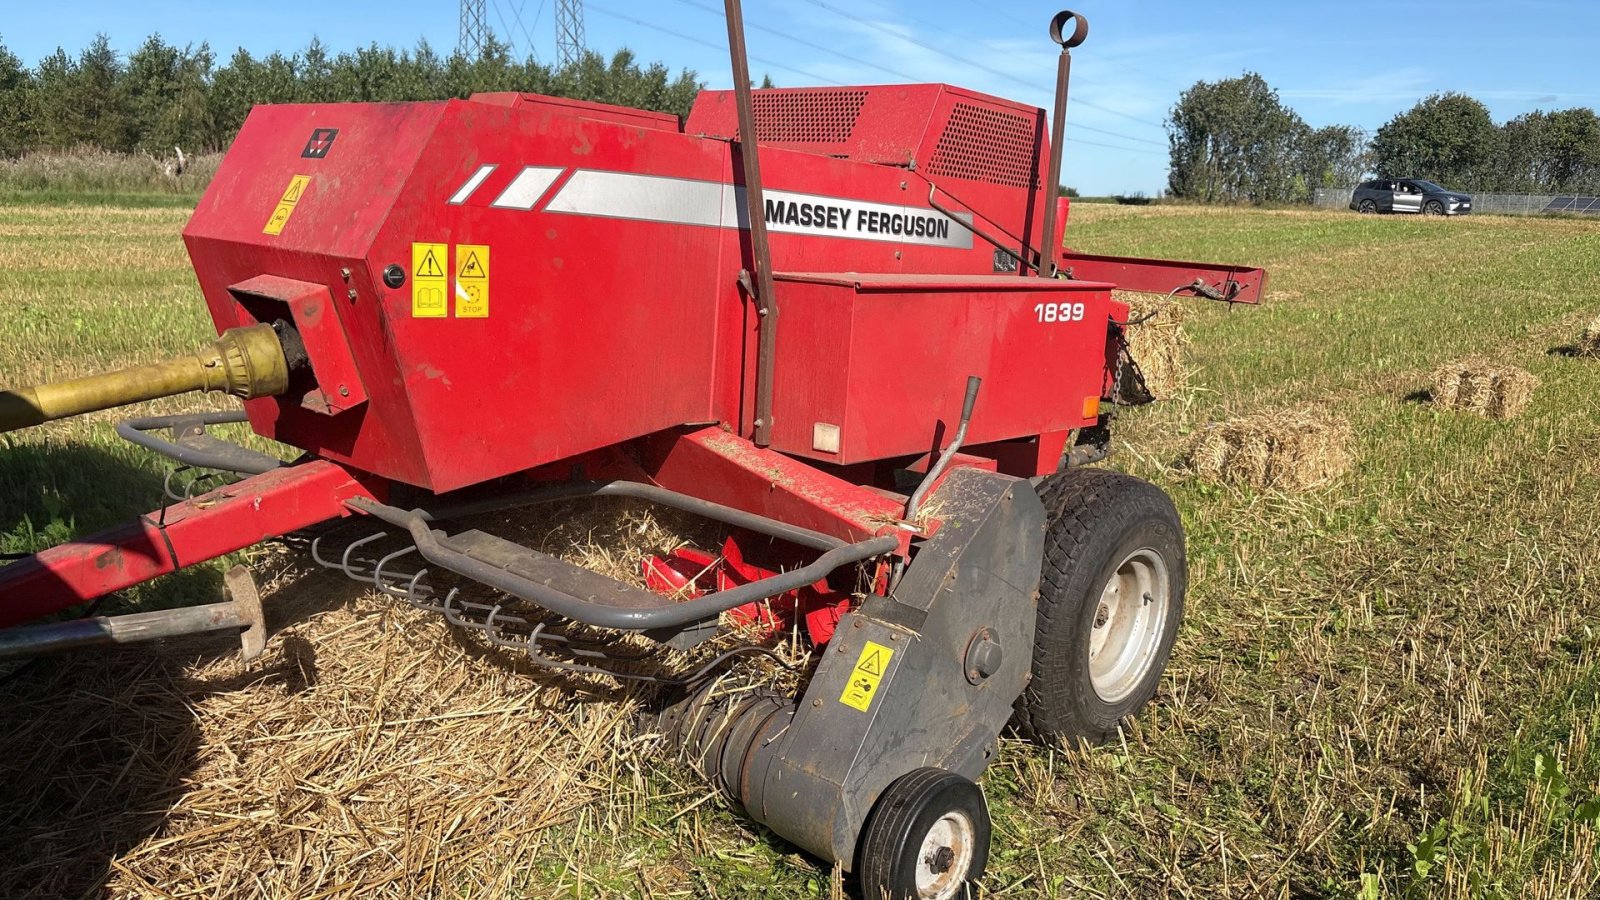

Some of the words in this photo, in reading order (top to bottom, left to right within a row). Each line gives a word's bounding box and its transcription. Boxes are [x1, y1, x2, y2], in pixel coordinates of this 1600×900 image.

[765, 199, 851, 230] MASSEY
[857, 210, 949, 239] FERGUSON
[1034, 302, 1085, 323] 1839
